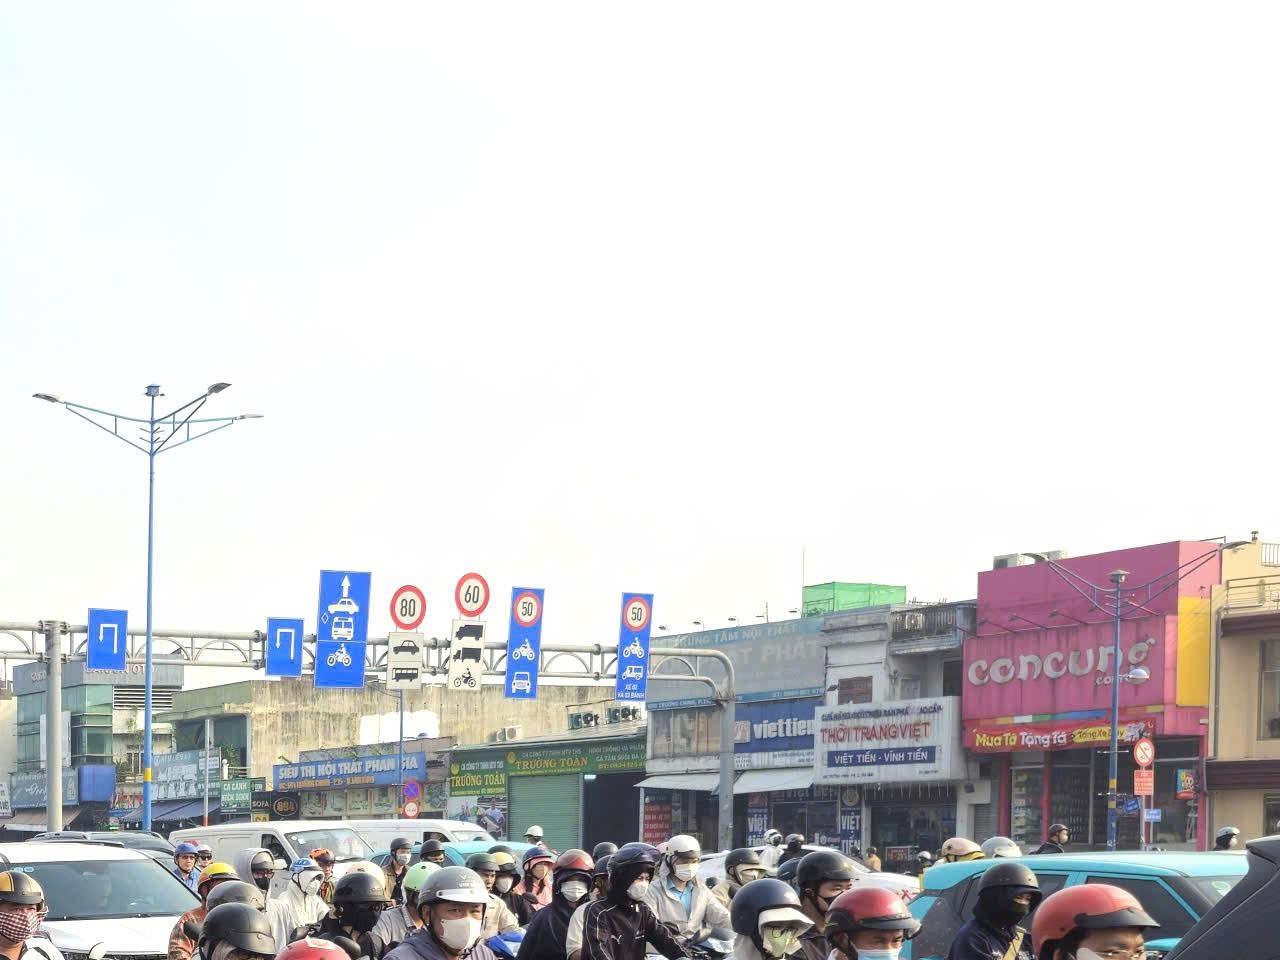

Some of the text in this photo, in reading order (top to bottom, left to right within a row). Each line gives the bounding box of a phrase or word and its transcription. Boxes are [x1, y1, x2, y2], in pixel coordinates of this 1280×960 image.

[464, 585, 480, 604] 60
[400, 599, 416, 617] 80
[521, 601, 533, 616] 50
[631, 607, 643, 621] 50
[854, 721, 898, 742] TRANG
[899, 719, 930, 742] VIỆT
[976, 733, 1001, 747] Mua
[834, 753, 853, 767] VIỆT
[857, 752, 876, 763] TIẾN
[908, 748, 928, 761] TIẾN
[451, 770, 505, 787] TRƯỜNG TOÀN
[252, 800, 269, 808] SOFA
